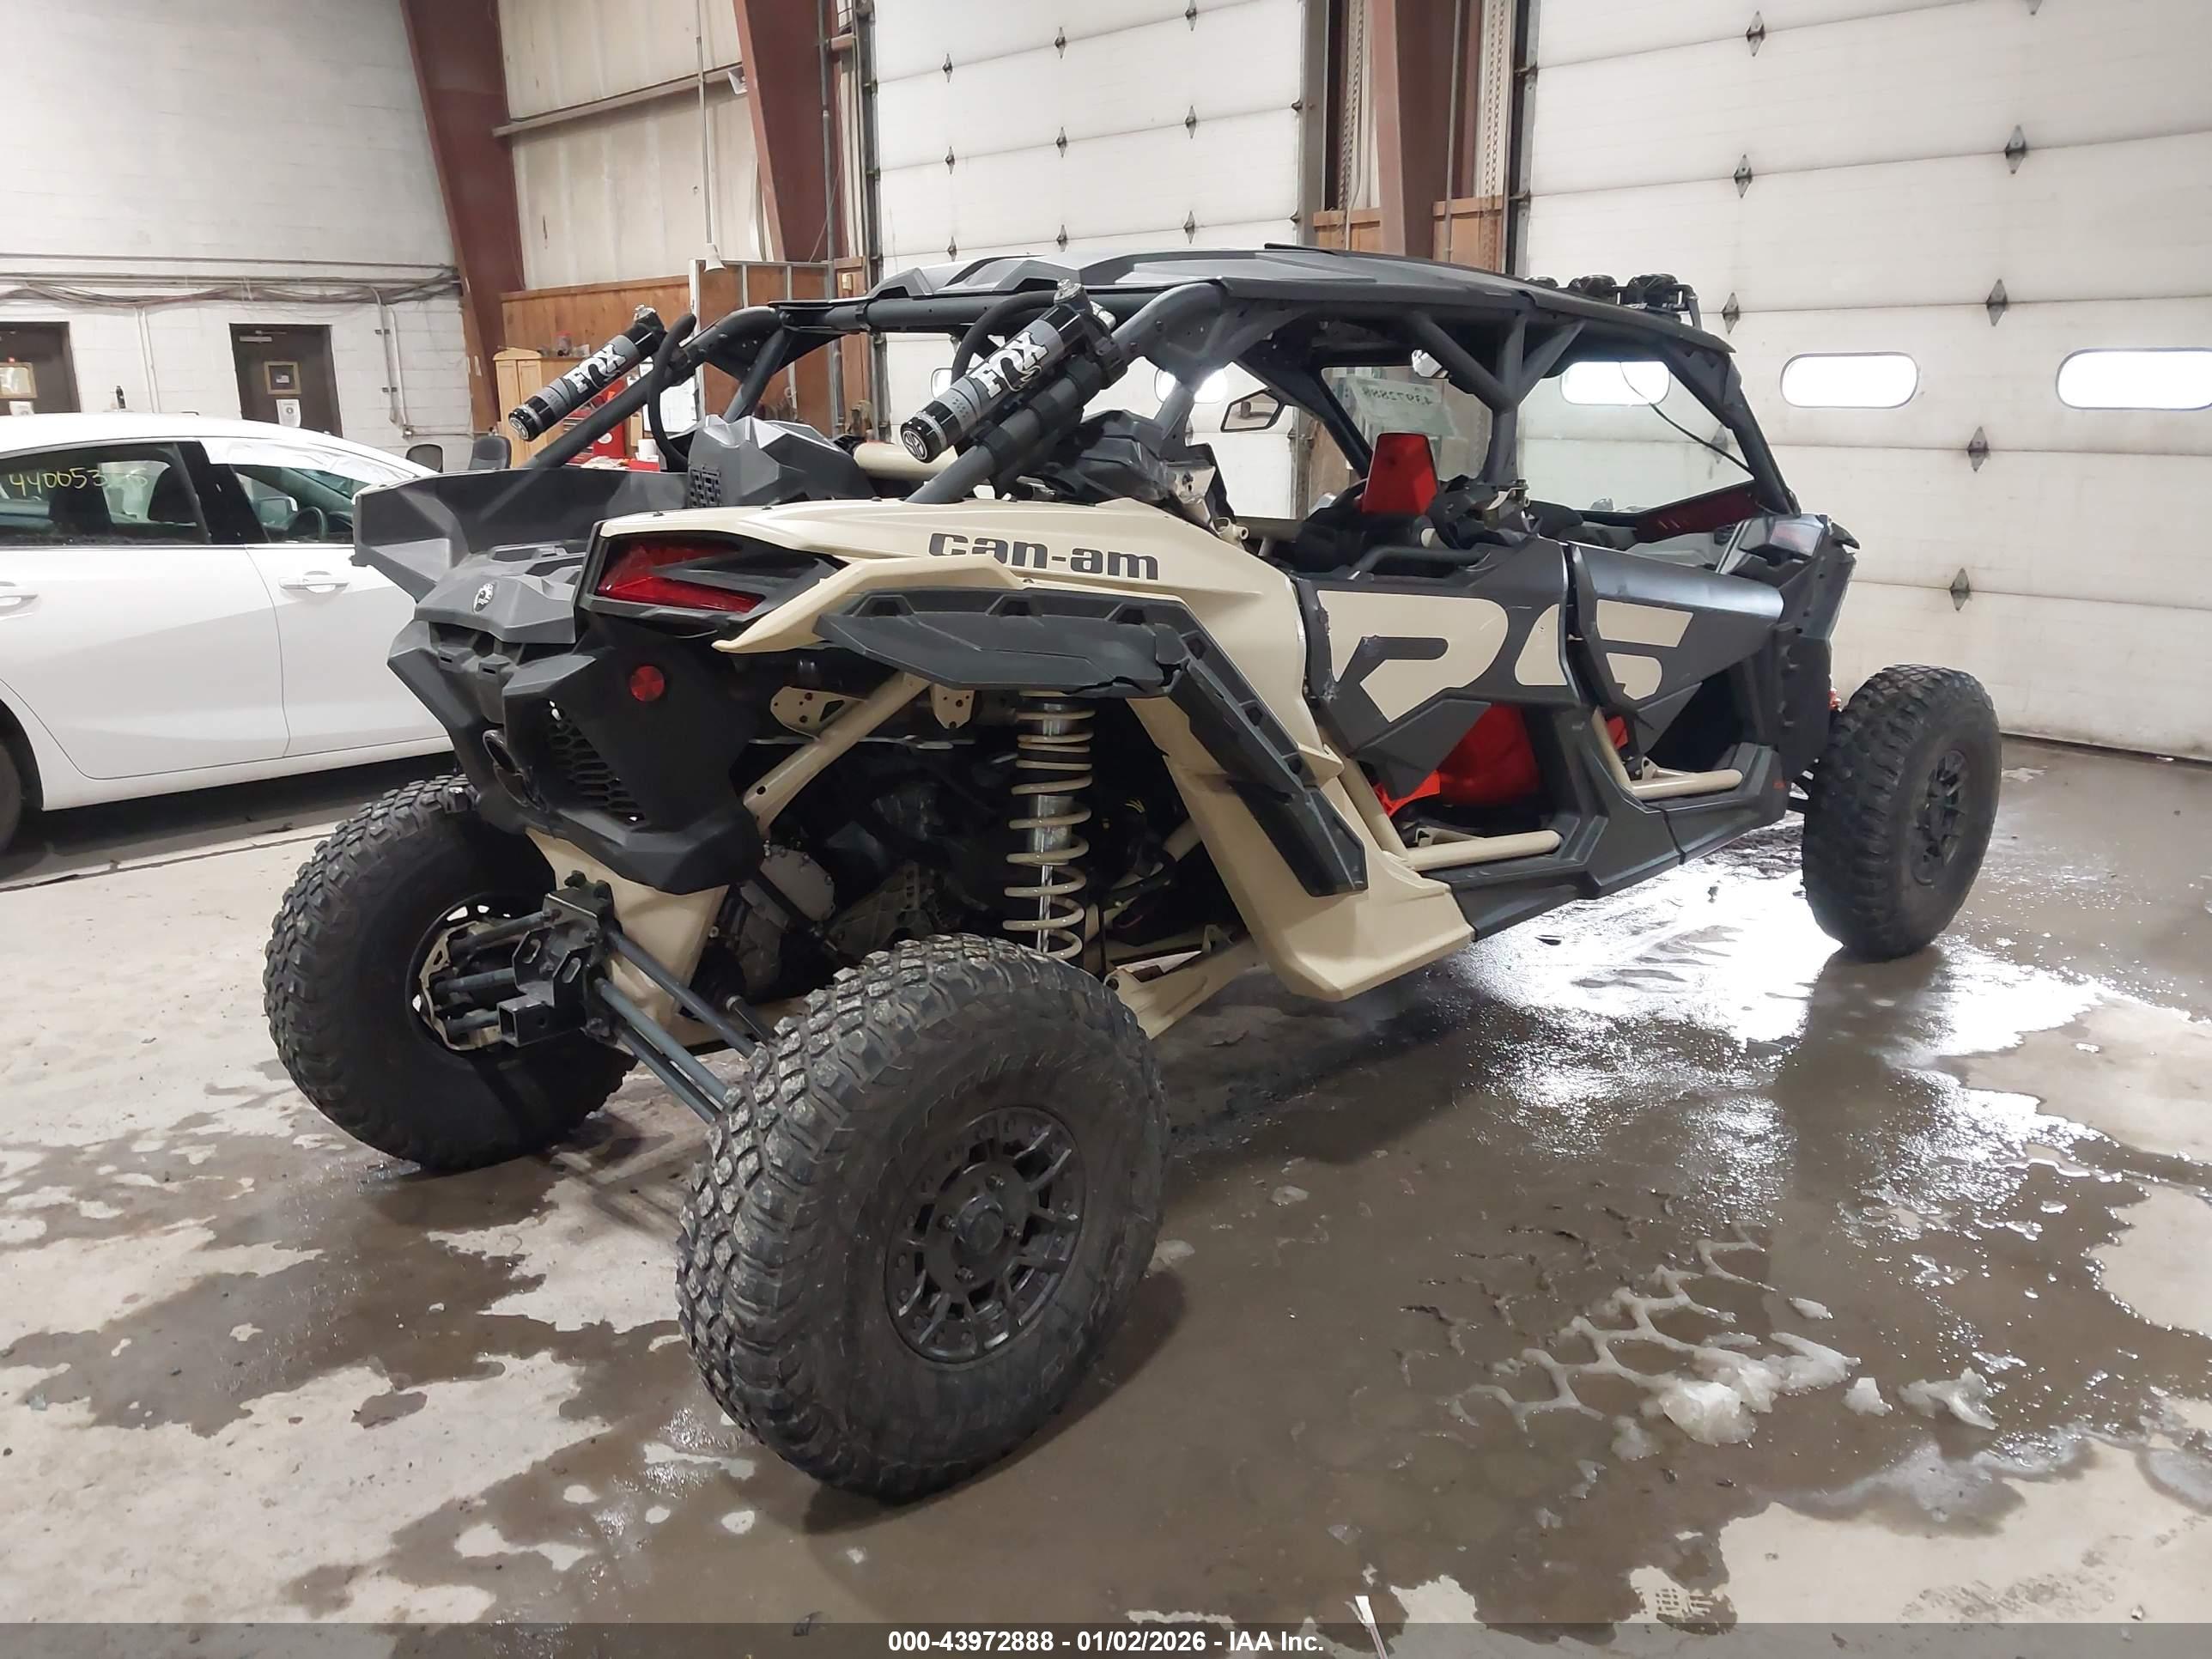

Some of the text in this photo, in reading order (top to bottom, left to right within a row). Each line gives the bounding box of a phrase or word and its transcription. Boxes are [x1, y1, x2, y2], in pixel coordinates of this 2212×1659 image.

[563, 343, 627, 393] FOX
[969, 331, 1048, 398] FOX
[928, 532, 1159, 580] can-am
